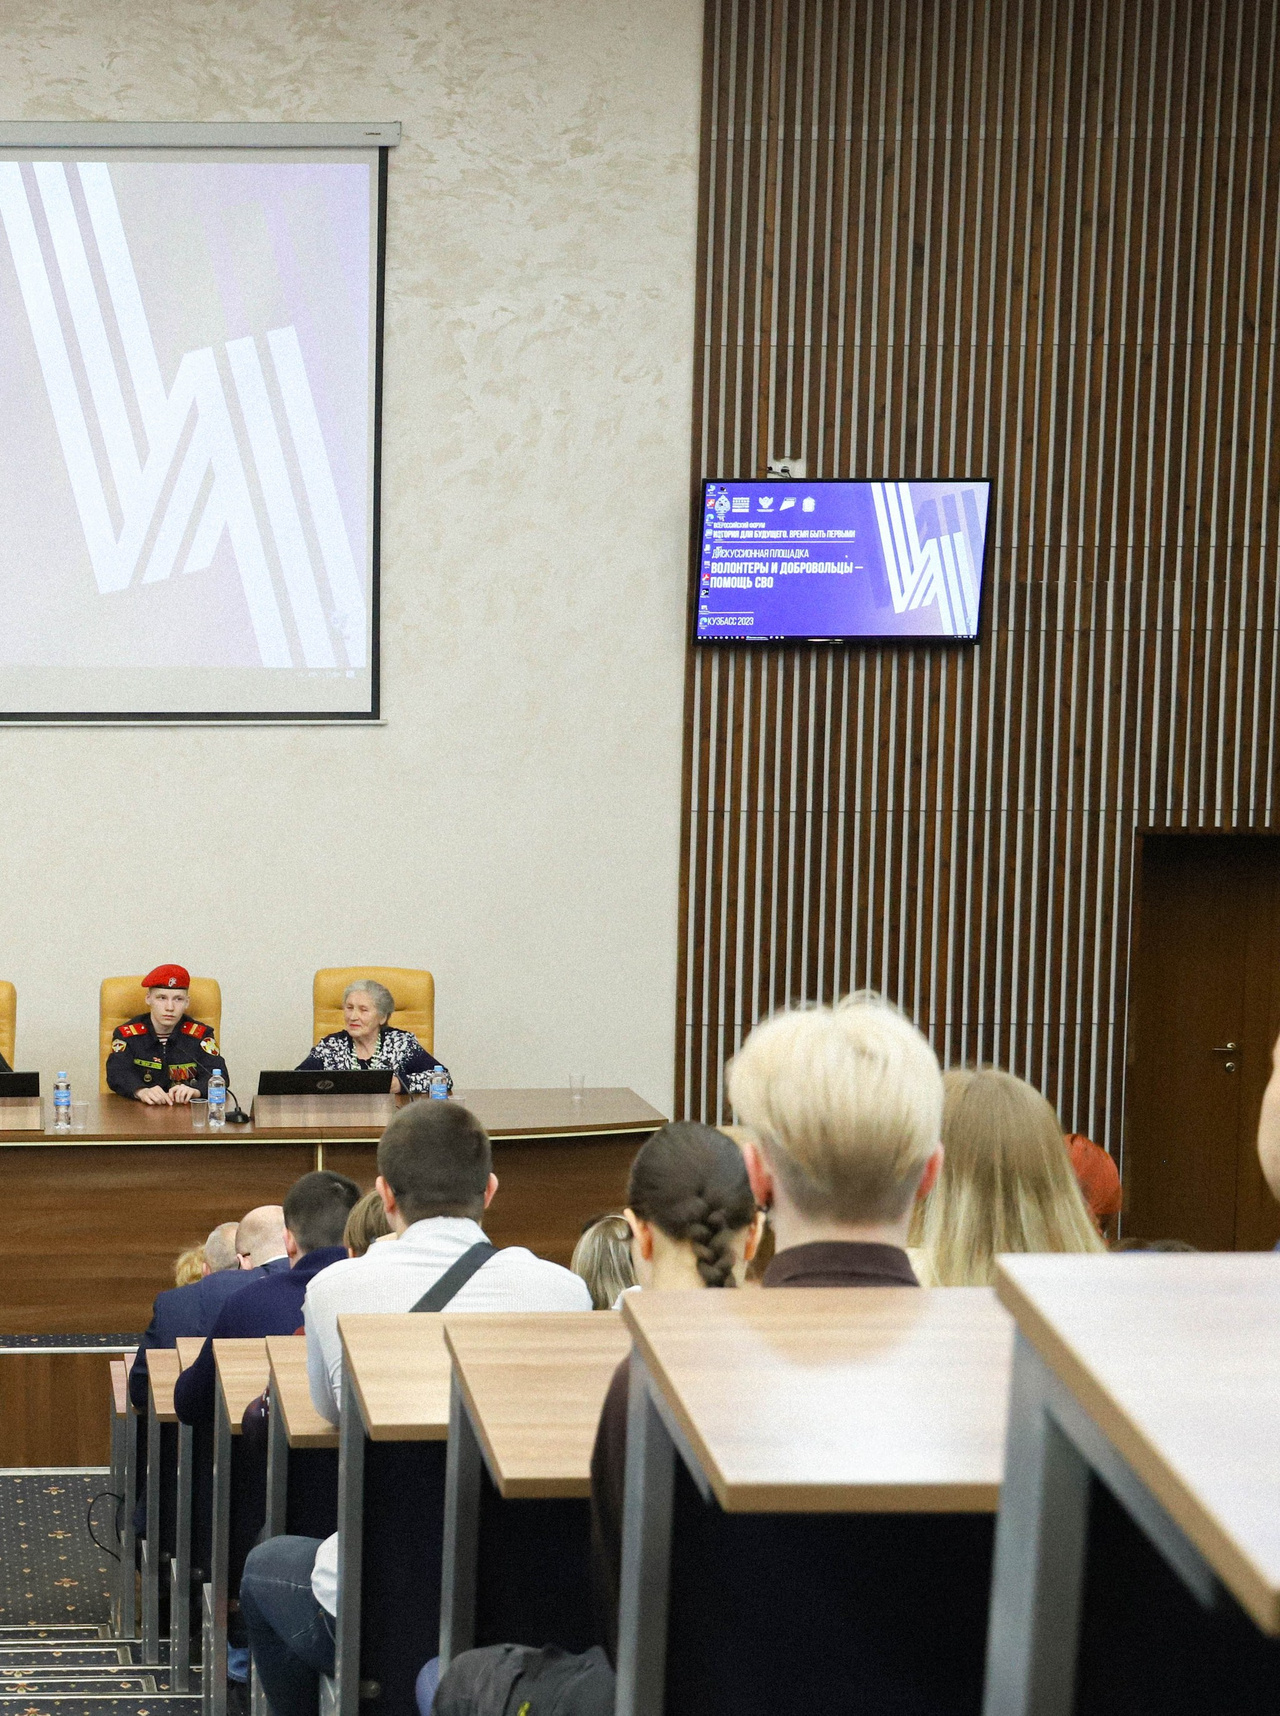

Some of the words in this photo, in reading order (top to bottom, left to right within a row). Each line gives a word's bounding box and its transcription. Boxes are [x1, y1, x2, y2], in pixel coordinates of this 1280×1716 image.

[710, 561, 769, 574] ВОЛОНТЕРЫ
[770, 562, 779, 574] И
[779, 561, 854, 575] ДОБРОВОЛЬЦЫ
[710, 576, 753, 590] ПОМОЩЬ
[754, 576, 774, 589] СВО
[707, 617, 737, 626] КУЗБАСС
[737, 617, 755, 626] 2023
